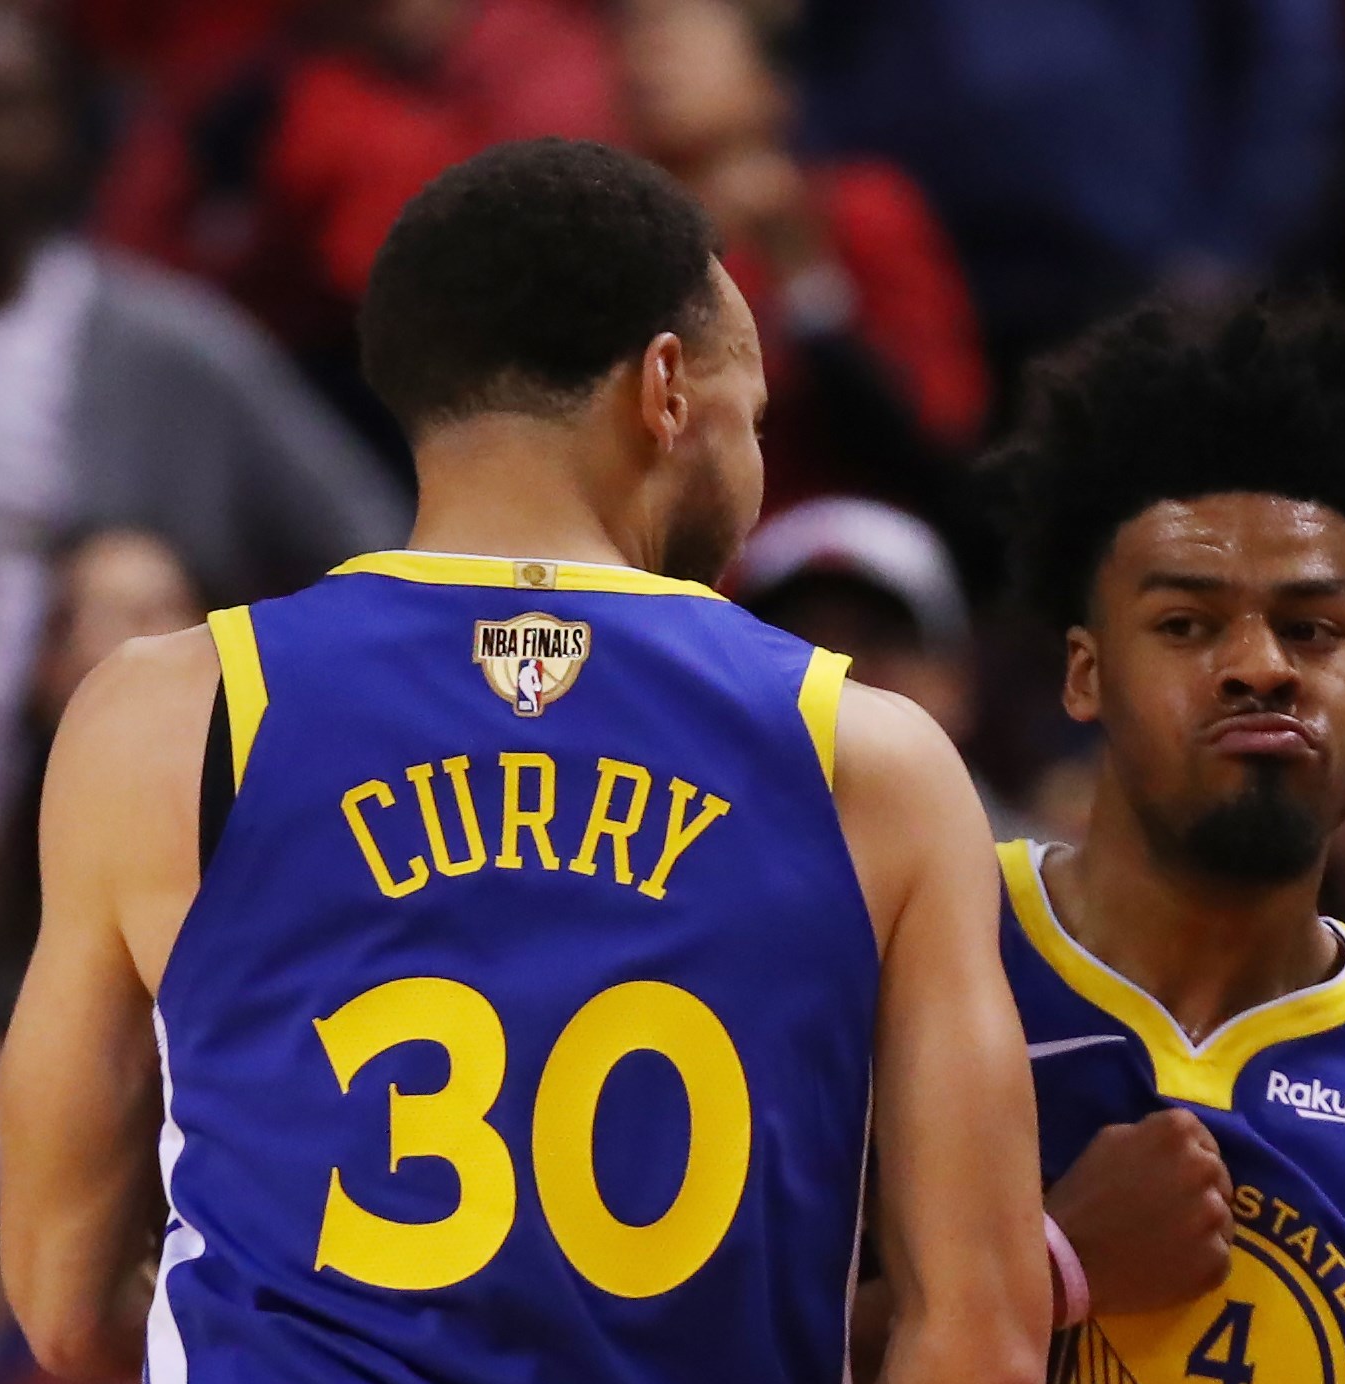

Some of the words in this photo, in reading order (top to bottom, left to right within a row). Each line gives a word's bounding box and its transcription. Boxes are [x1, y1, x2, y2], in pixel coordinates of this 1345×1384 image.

[481, 627, 518, 657] NBA
[522, 627, 582, 658] FINALS
[341, 752, 731, 899] CURRY
[312, 976, 752, 1299] 30
